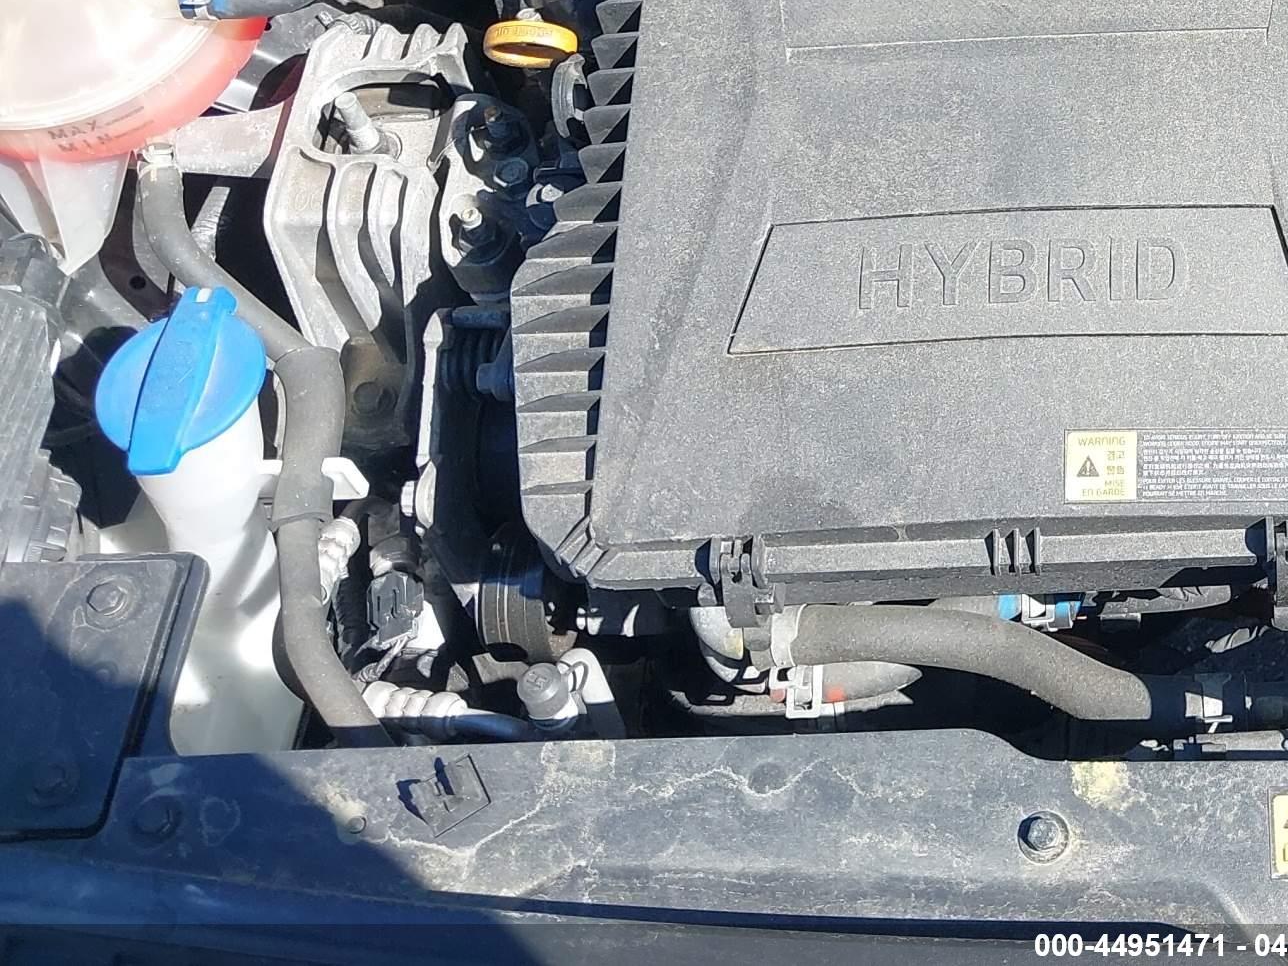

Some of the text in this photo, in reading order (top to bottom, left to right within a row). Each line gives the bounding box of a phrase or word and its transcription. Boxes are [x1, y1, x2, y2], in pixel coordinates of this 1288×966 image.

[47, 119, 98, 140] MAX
[858, 234, 1187, 310] HYBRID
[1077, 436, 1126, 447] WARNING
